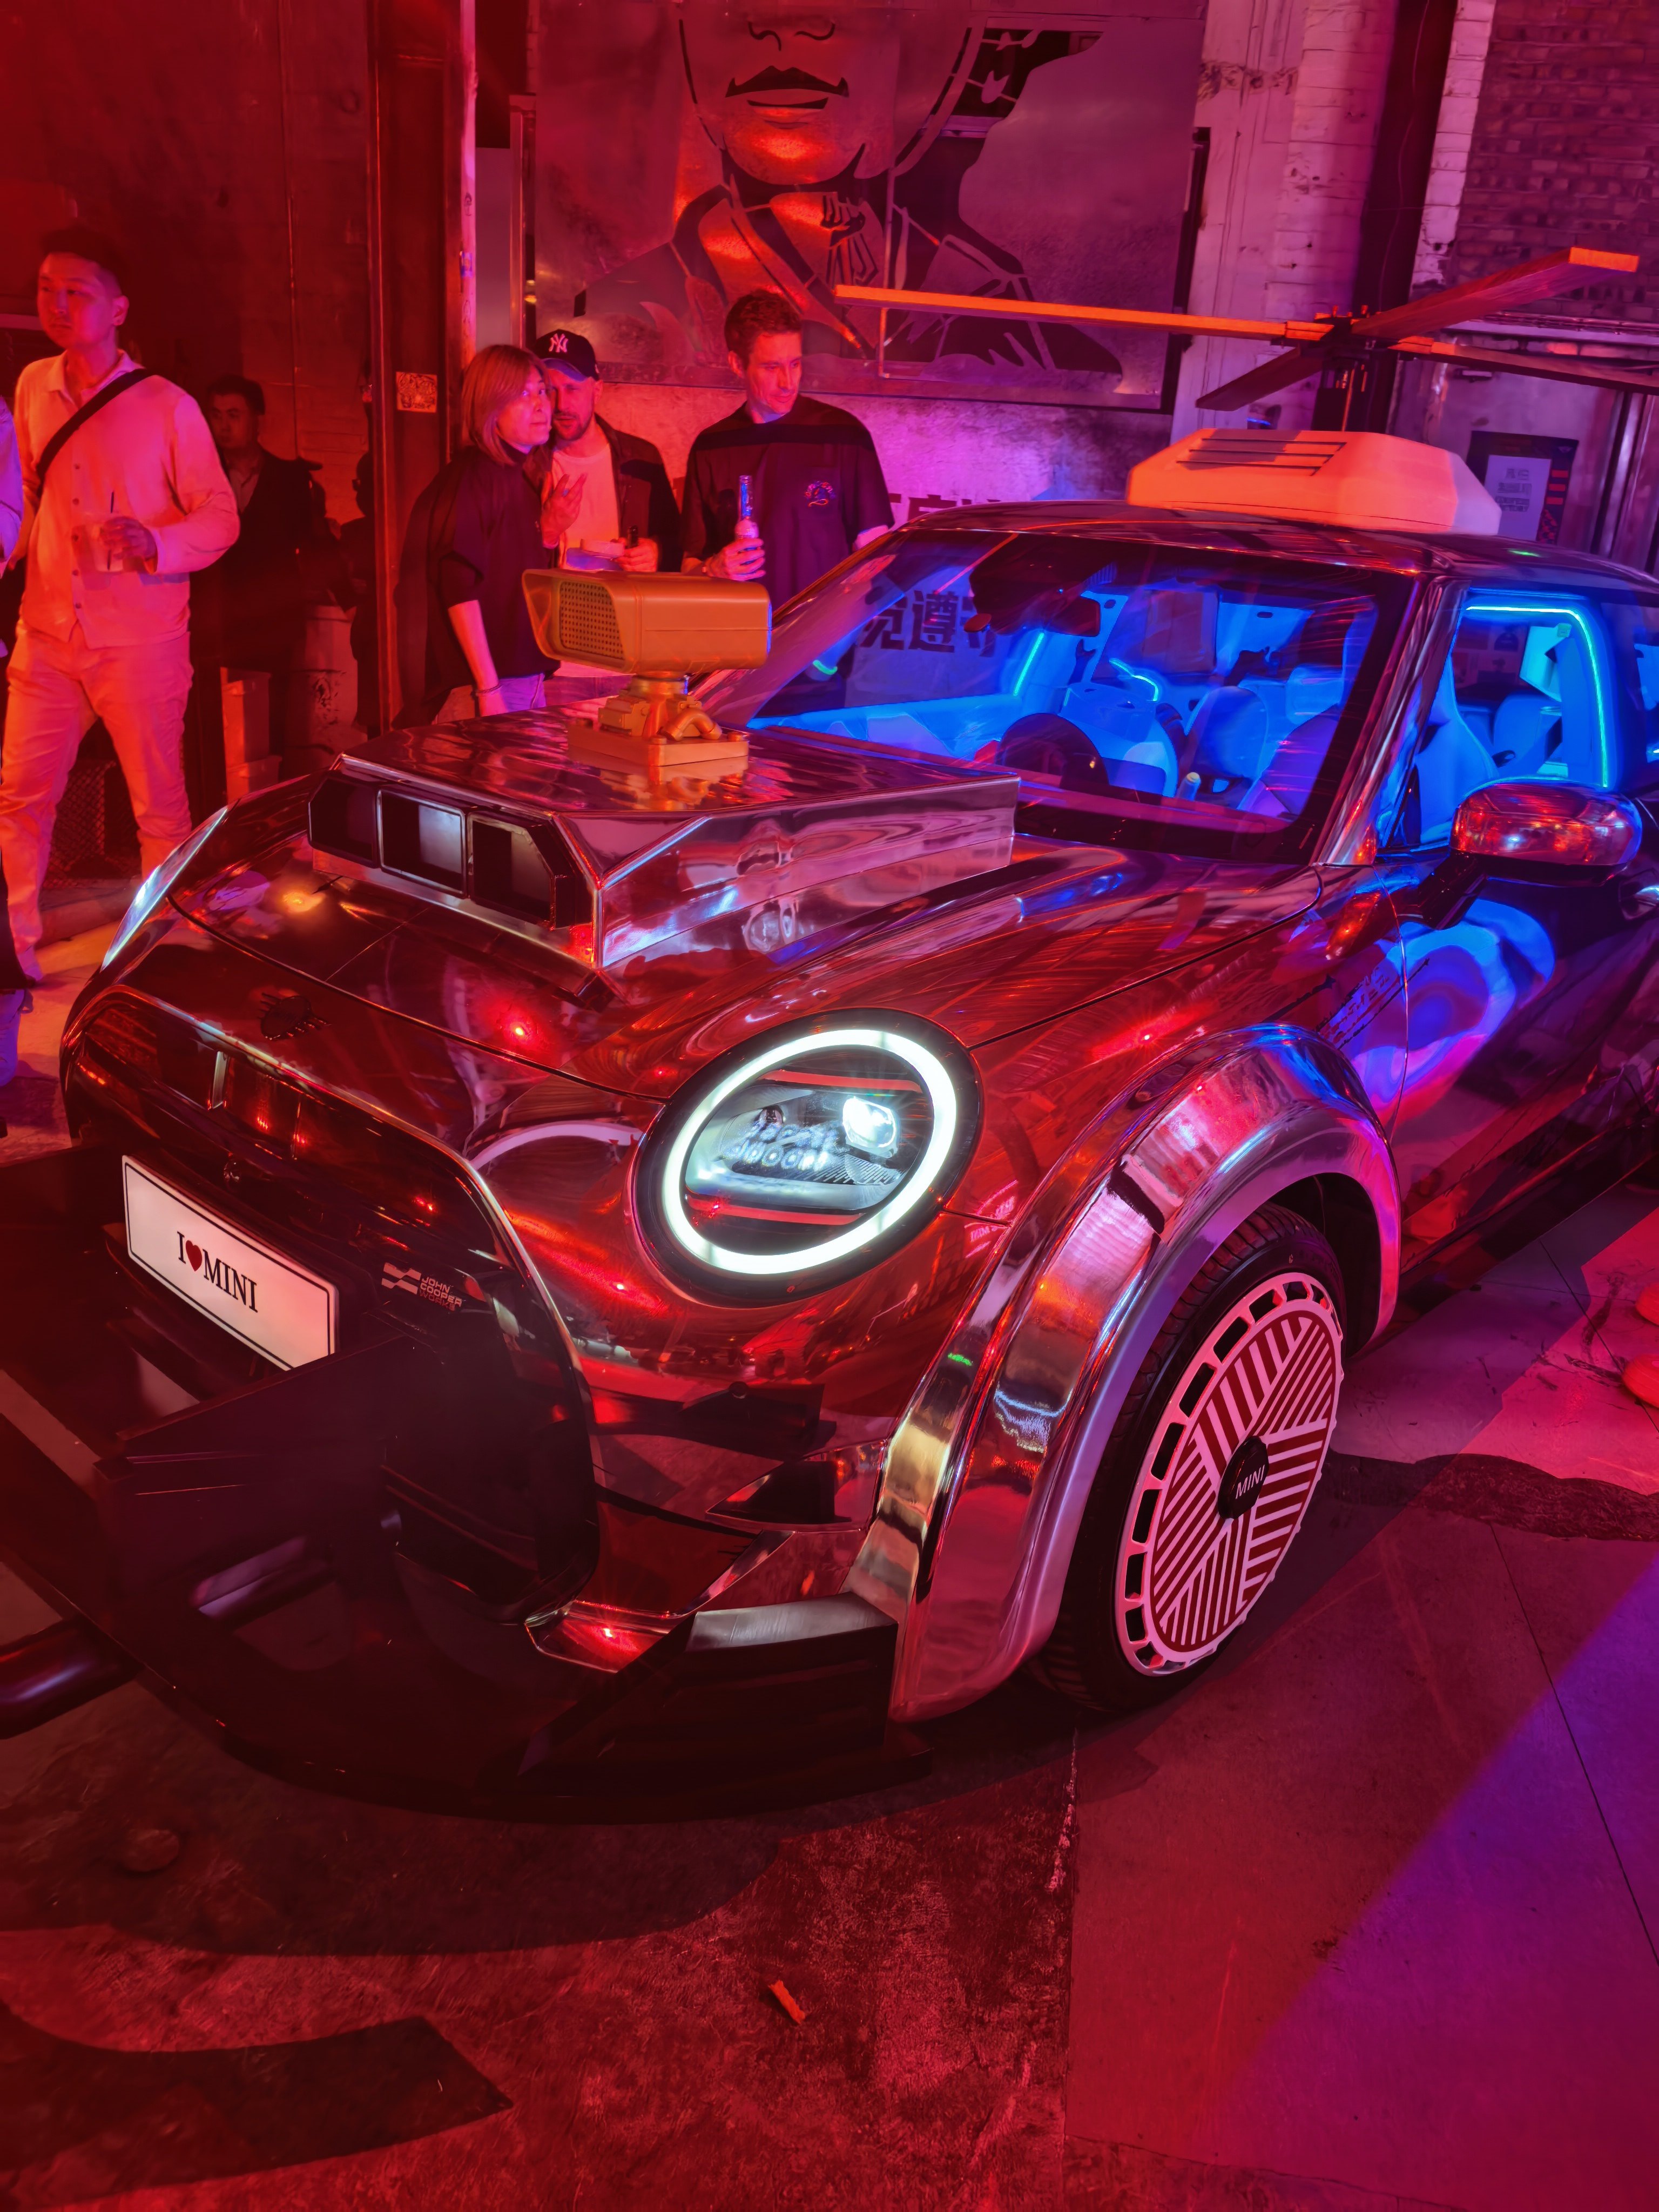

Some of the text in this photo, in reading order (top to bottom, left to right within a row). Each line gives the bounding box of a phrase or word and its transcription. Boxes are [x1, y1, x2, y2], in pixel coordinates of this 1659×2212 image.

[549, 333, 568, 353] NY
[203, 1249, 258, 1313] MINI
[422, 1276, 450, 1293] JOHN
[419, 1289, 456, 1311] WORKS
[420, 1282, 462, 1307] COOPER
[1235, 1464, 1265, 1500] MINI
